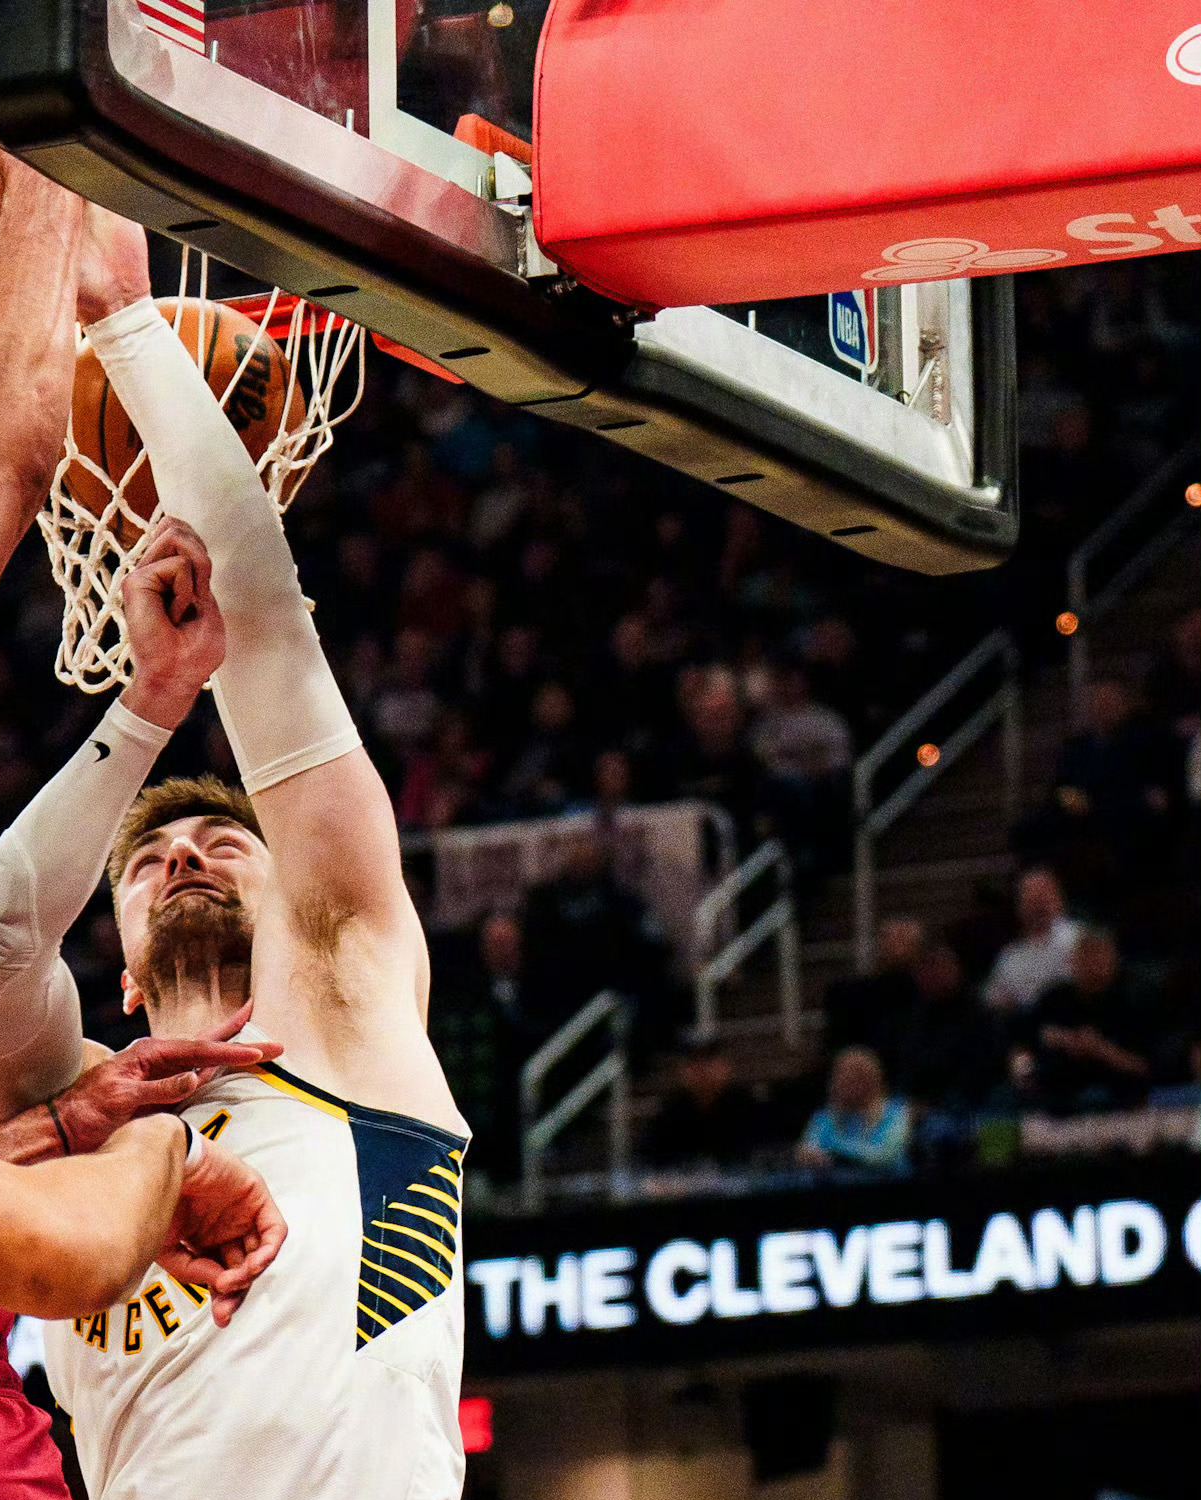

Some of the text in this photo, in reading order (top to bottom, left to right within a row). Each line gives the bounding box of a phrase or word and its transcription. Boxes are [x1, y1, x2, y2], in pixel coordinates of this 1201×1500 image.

[836, 302, 860, 350] NBA
[466, 1246, 638, 1339] THE
[644, 1199, 1167, 1325] CLEVELAND
